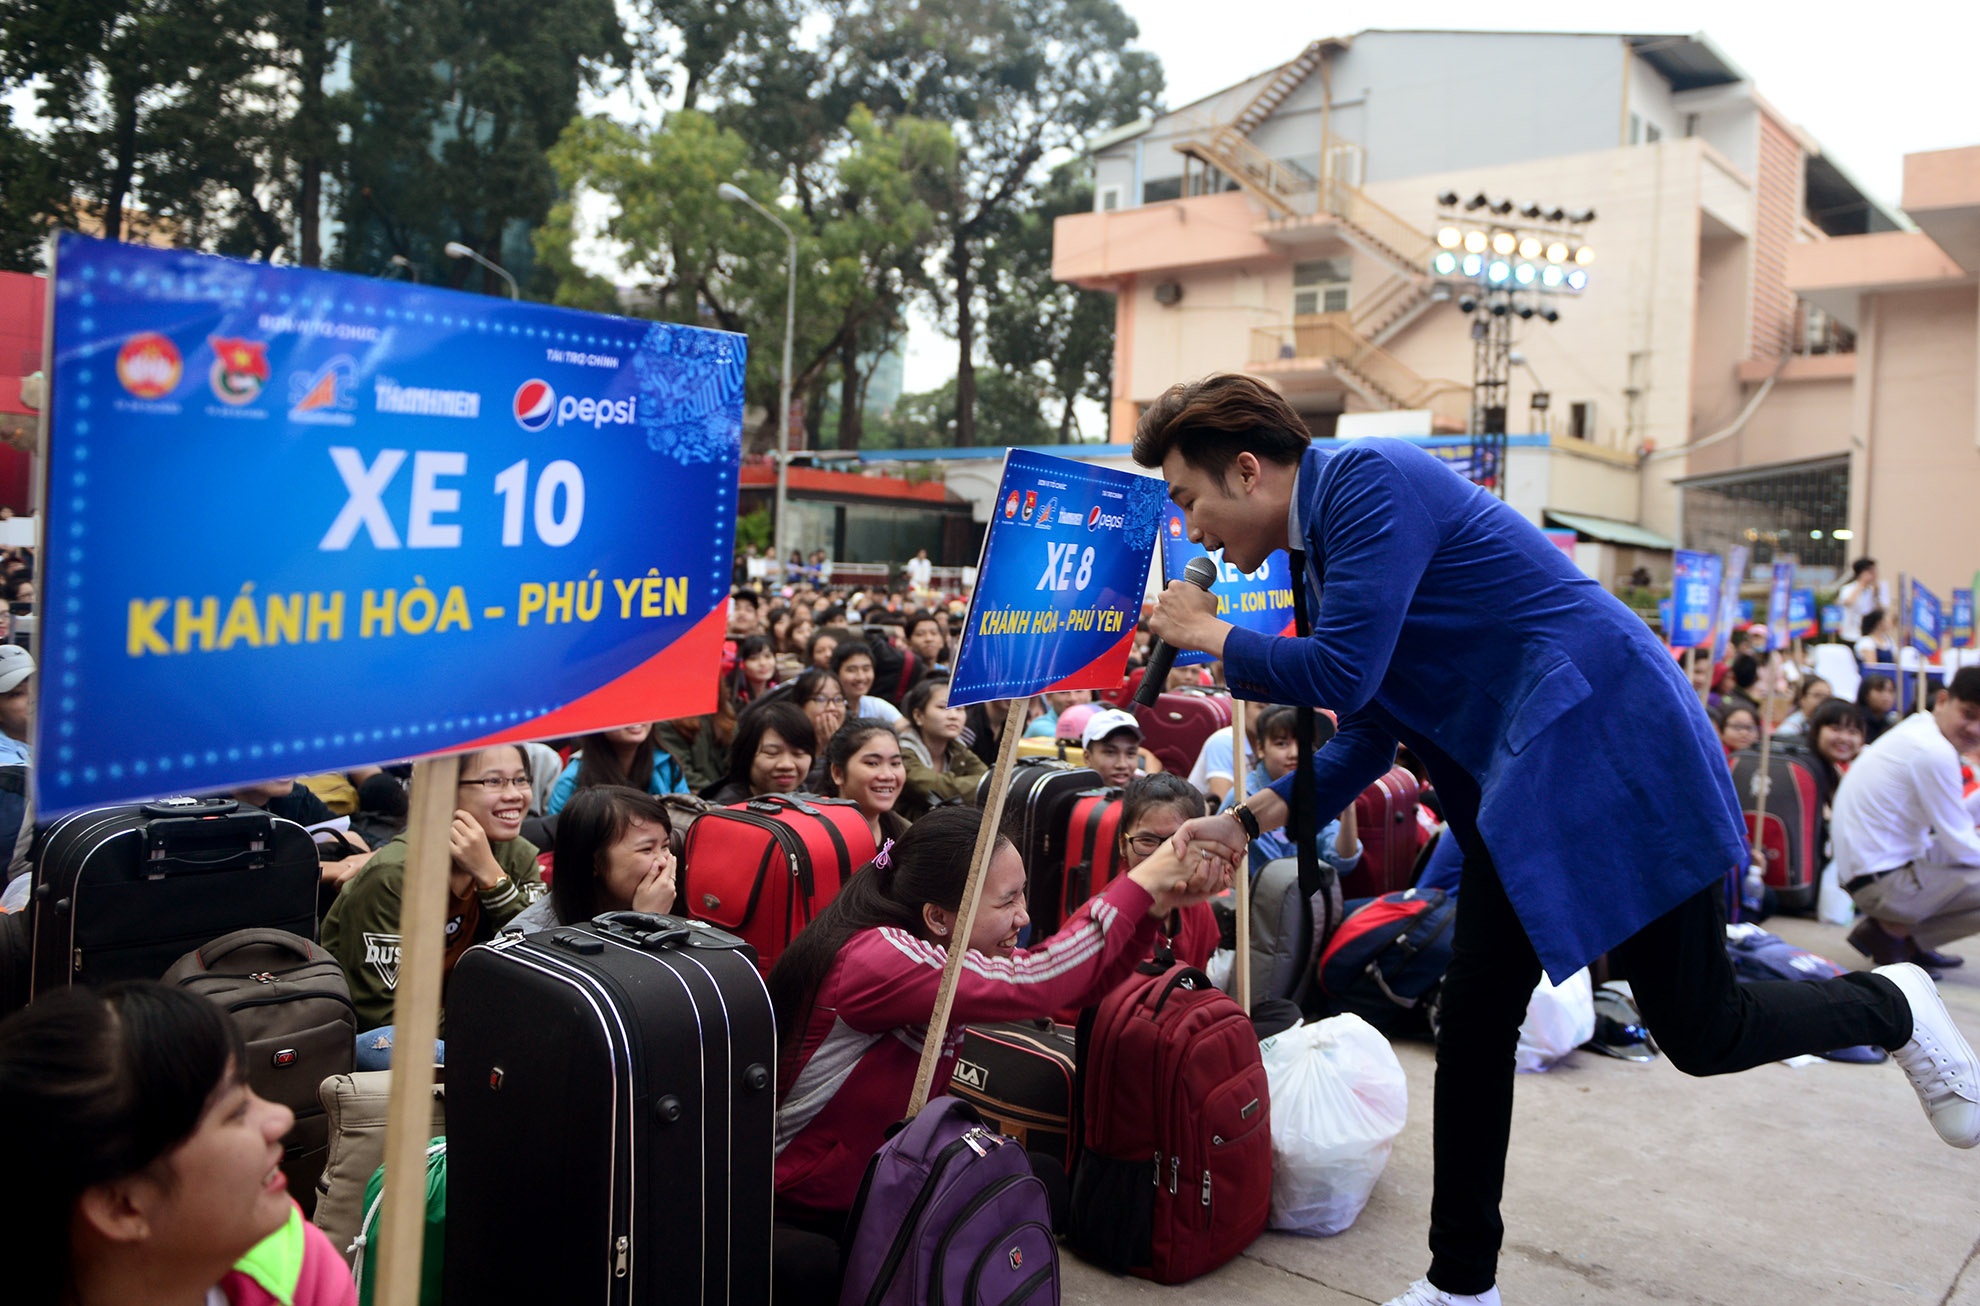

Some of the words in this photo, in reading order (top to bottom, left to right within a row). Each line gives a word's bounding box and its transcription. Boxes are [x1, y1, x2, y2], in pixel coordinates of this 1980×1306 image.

[557, 395, 637, 430] pepsi
[317, 445, 469, 551] XE
[493, 457, 586, 548] 10
[1097, 513, 1125, 531] pepsi
[1035, 541, 1079, 591] XE
[1074, 546, 1096, 591] 8
[126, 580, 346, 657] KHÁNH
[358, 573, 474, 639] HÒA
[517, 568, 604, 627] PHÚ
[612, 567, 690, 620] YÊN
[1217, 594, 1230, 615] AI
[1240, 590, 1267, 613] KON
[1267, 588, 1295, 610] TUM
[978, 603, 1032, 636] KHÁNH
[1030, 605, 1059, 634] HÒA
[1065, 604, 1096, 632] PHÚ
[1097, 605, 1124, 632] YÊN
[364, 944, 403, 964] DUS
[953, 1060, 980, 1086] ILA
